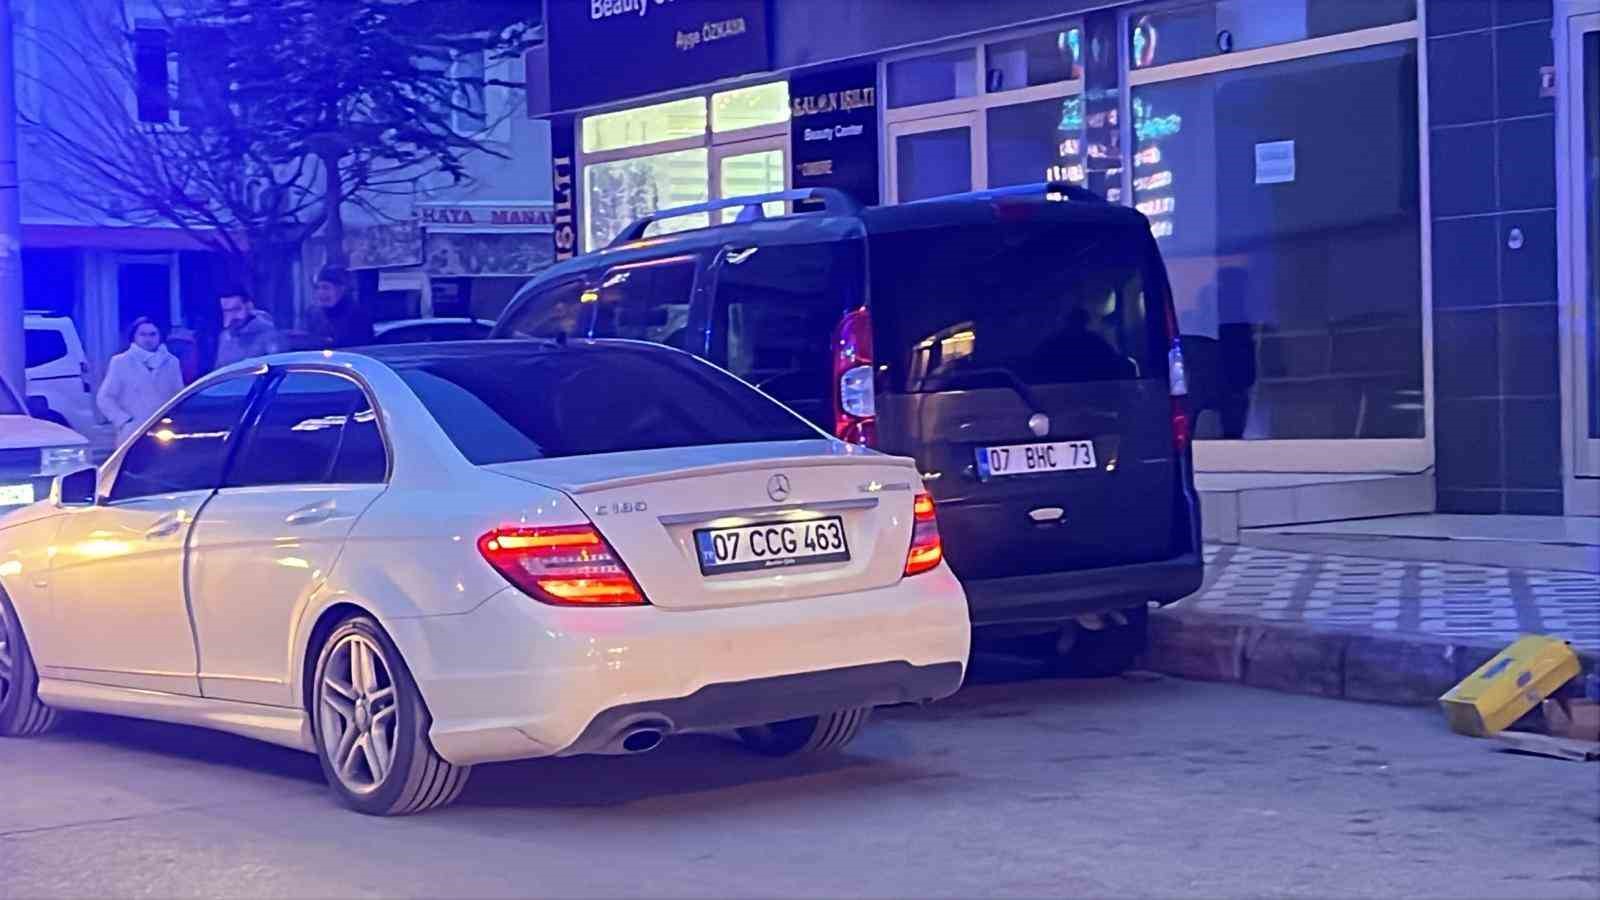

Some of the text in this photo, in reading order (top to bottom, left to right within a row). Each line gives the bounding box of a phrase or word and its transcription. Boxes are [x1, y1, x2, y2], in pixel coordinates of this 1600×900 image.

[591, 0, 647, 19] Beauty
[990, 443, 1090, 471] 07 BHC 73
[713, 522, 842, 561] 07 CCG 463
